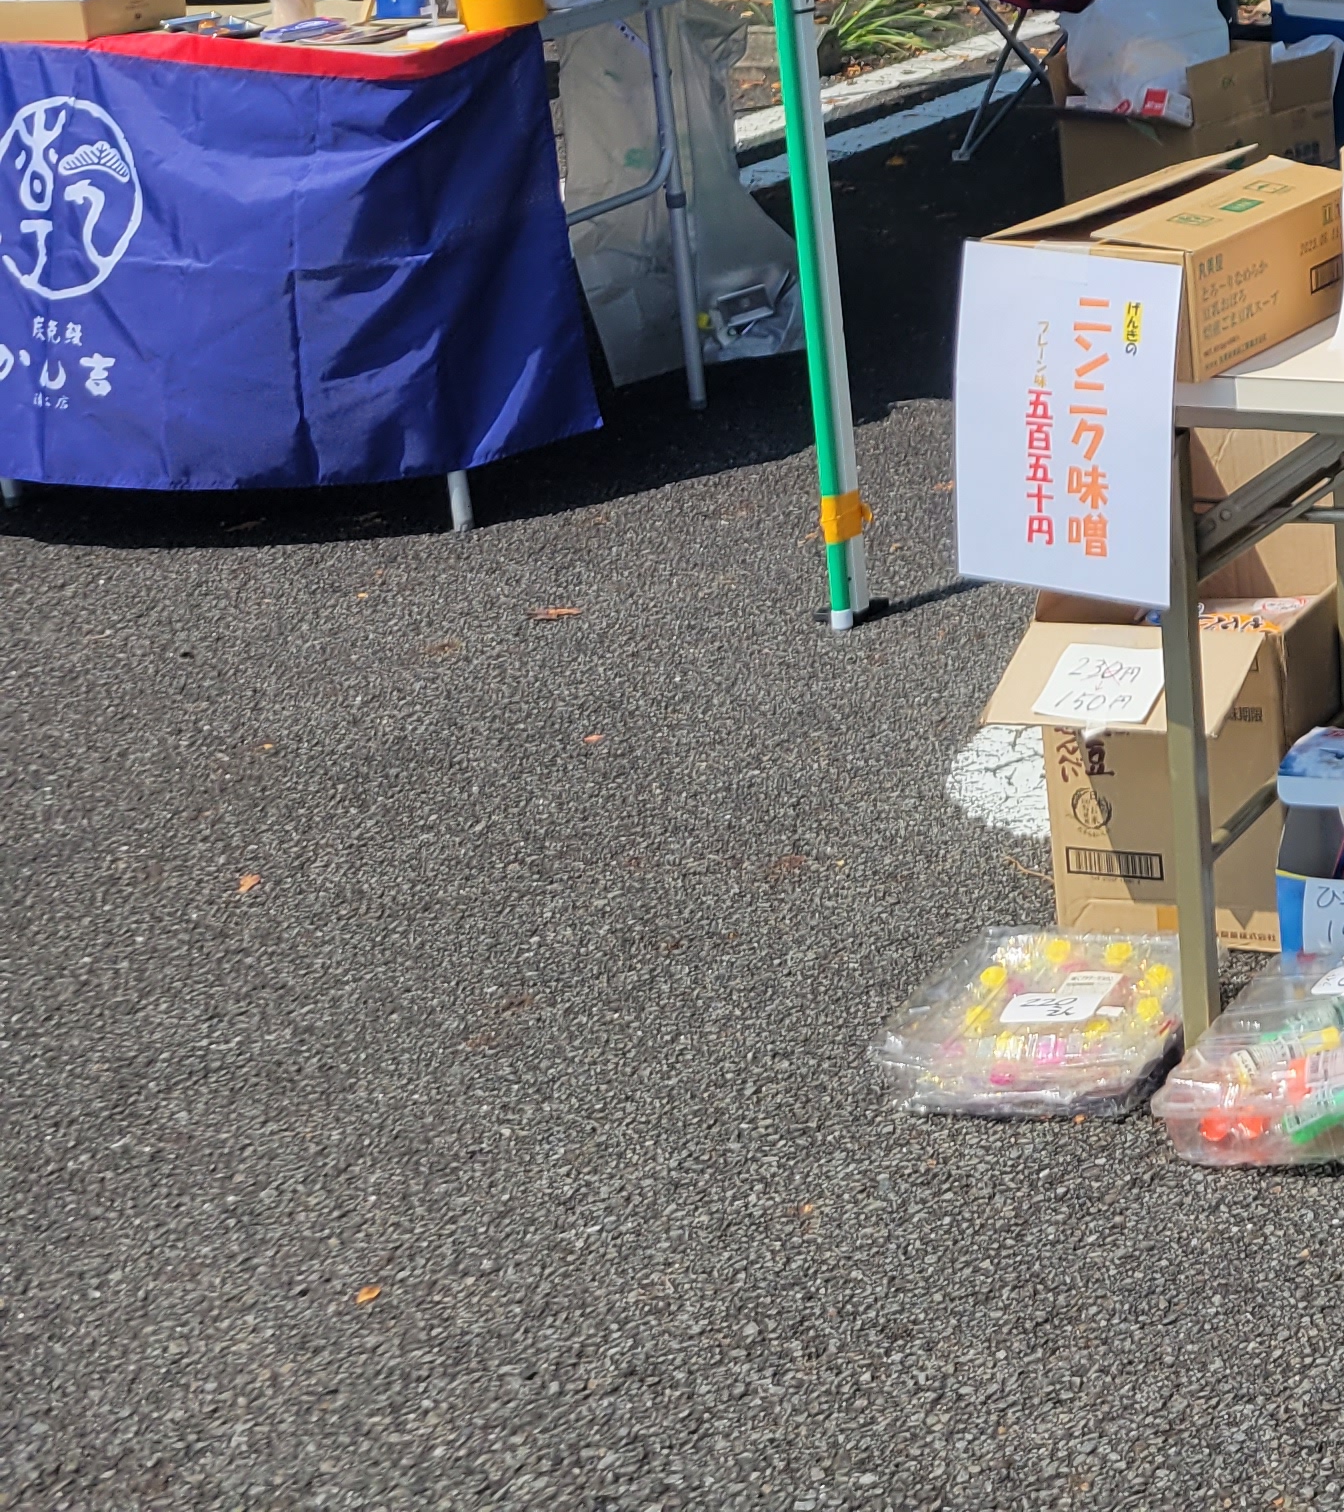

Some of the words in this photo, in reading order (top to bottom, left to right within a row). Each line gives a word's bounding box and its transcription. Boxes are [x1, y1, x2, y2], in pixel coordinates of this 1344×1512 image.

[1125, 301, 1142, 357] げんきの
[1025, 388, 1055, 546] 五百五十円
[1066, 296, 1113, 558] ニンニク味噌
